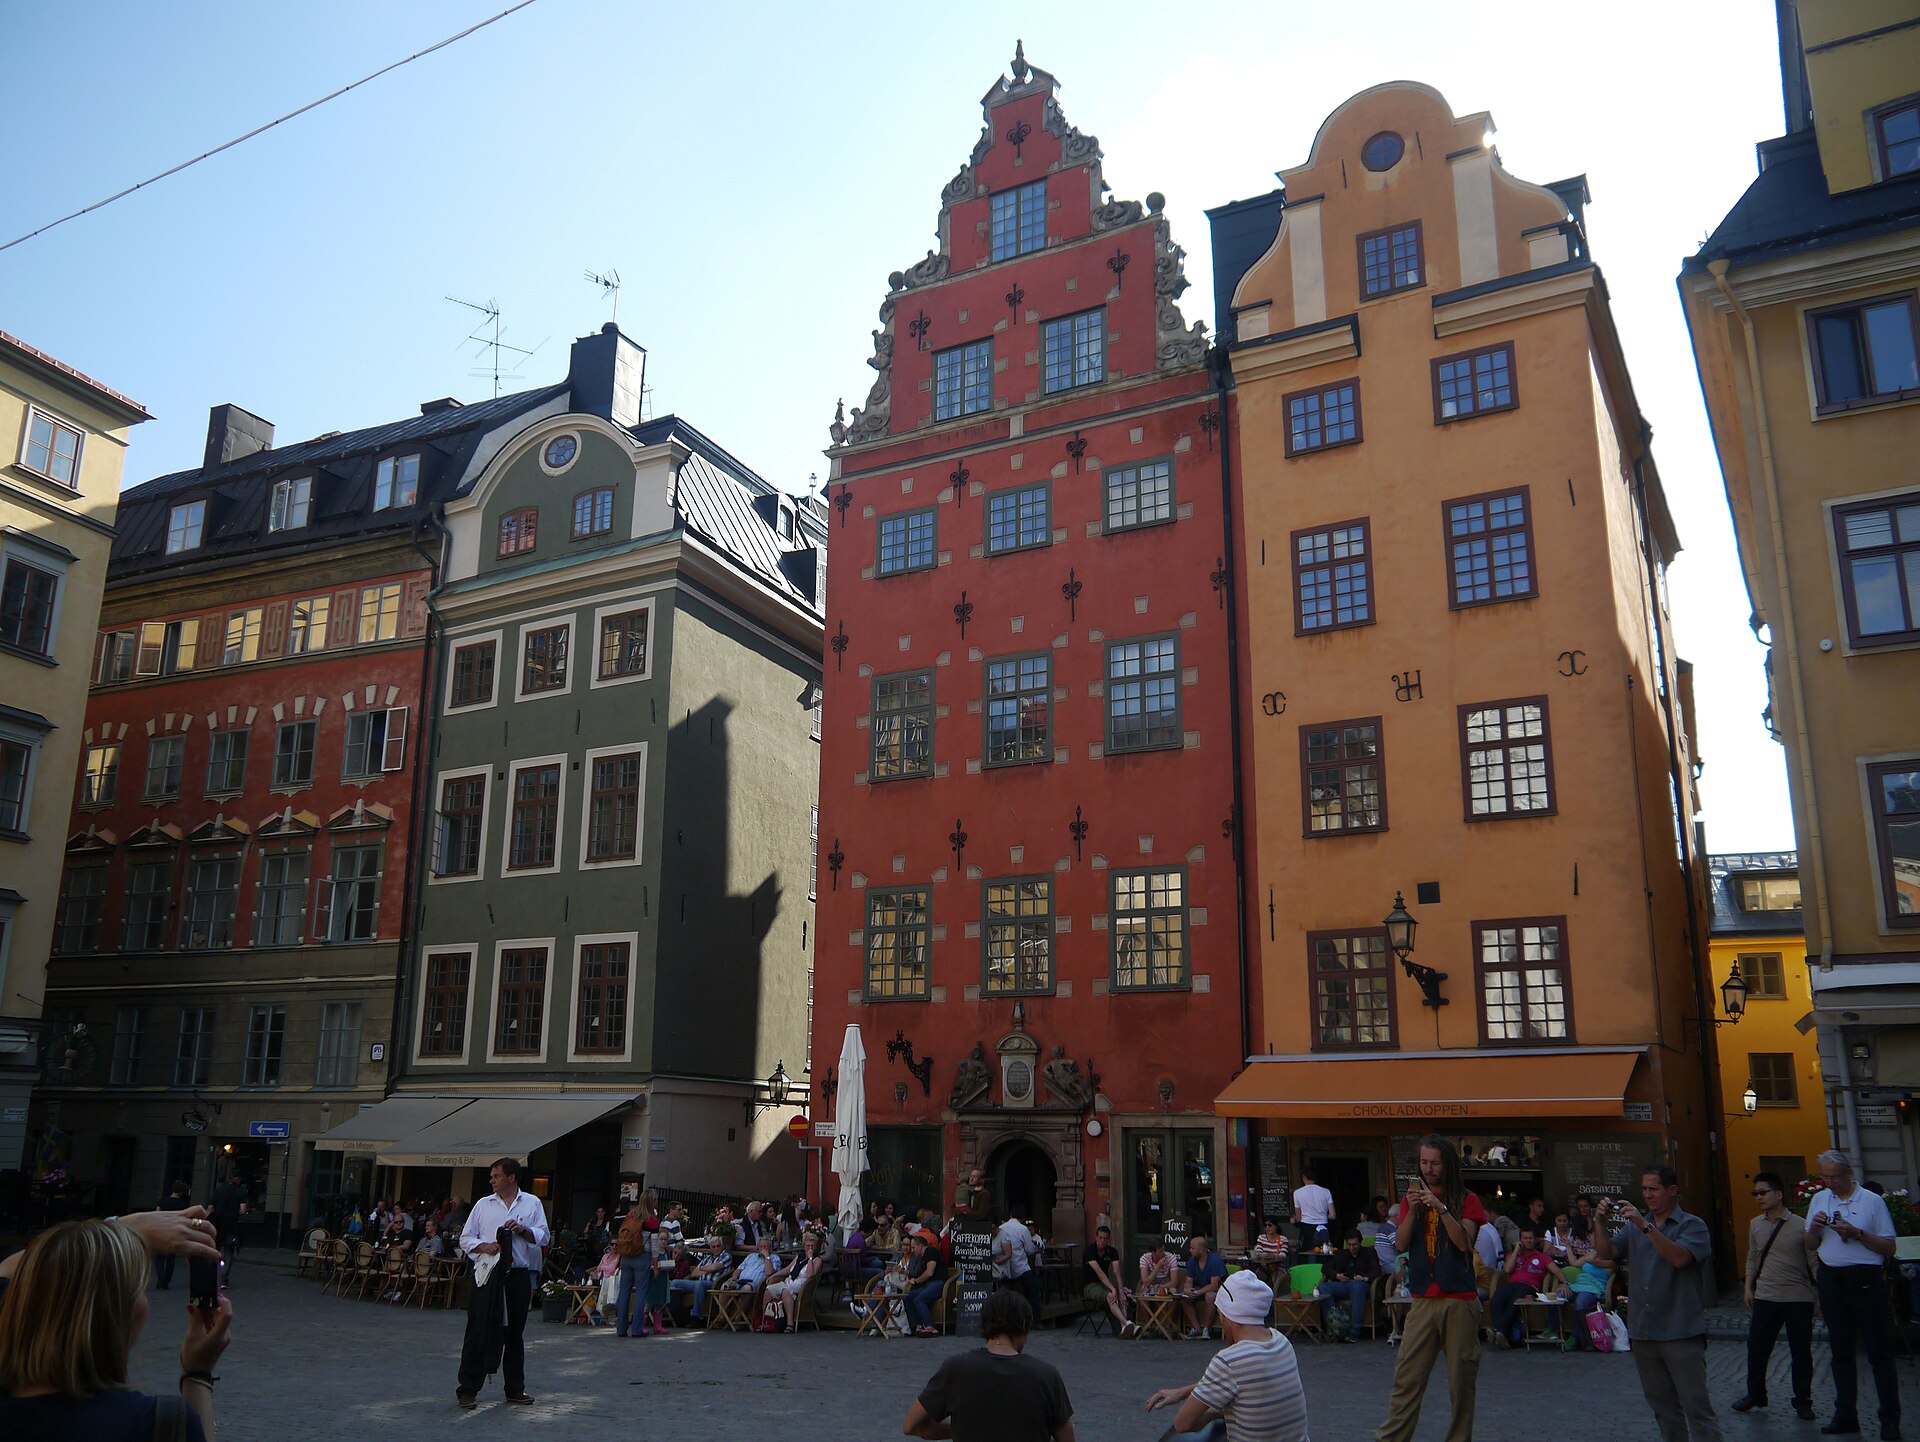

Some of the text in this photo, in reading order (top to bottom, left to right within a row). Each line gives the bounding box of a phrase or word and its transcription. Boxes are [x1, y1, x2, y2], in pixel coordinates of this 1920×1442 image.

[1352, 1104, 1469, 1116] CHOKLADKOPPEN
[1625, 1104, 1650, 1112] tortorget
[425, 1155, 457, 1165] Restaurang
[464, 1156, 475, 1164] Bar
[1163, 1219, 1187, 1232] TAKE
[1164, 1233, 1188, 1249] AWAY
